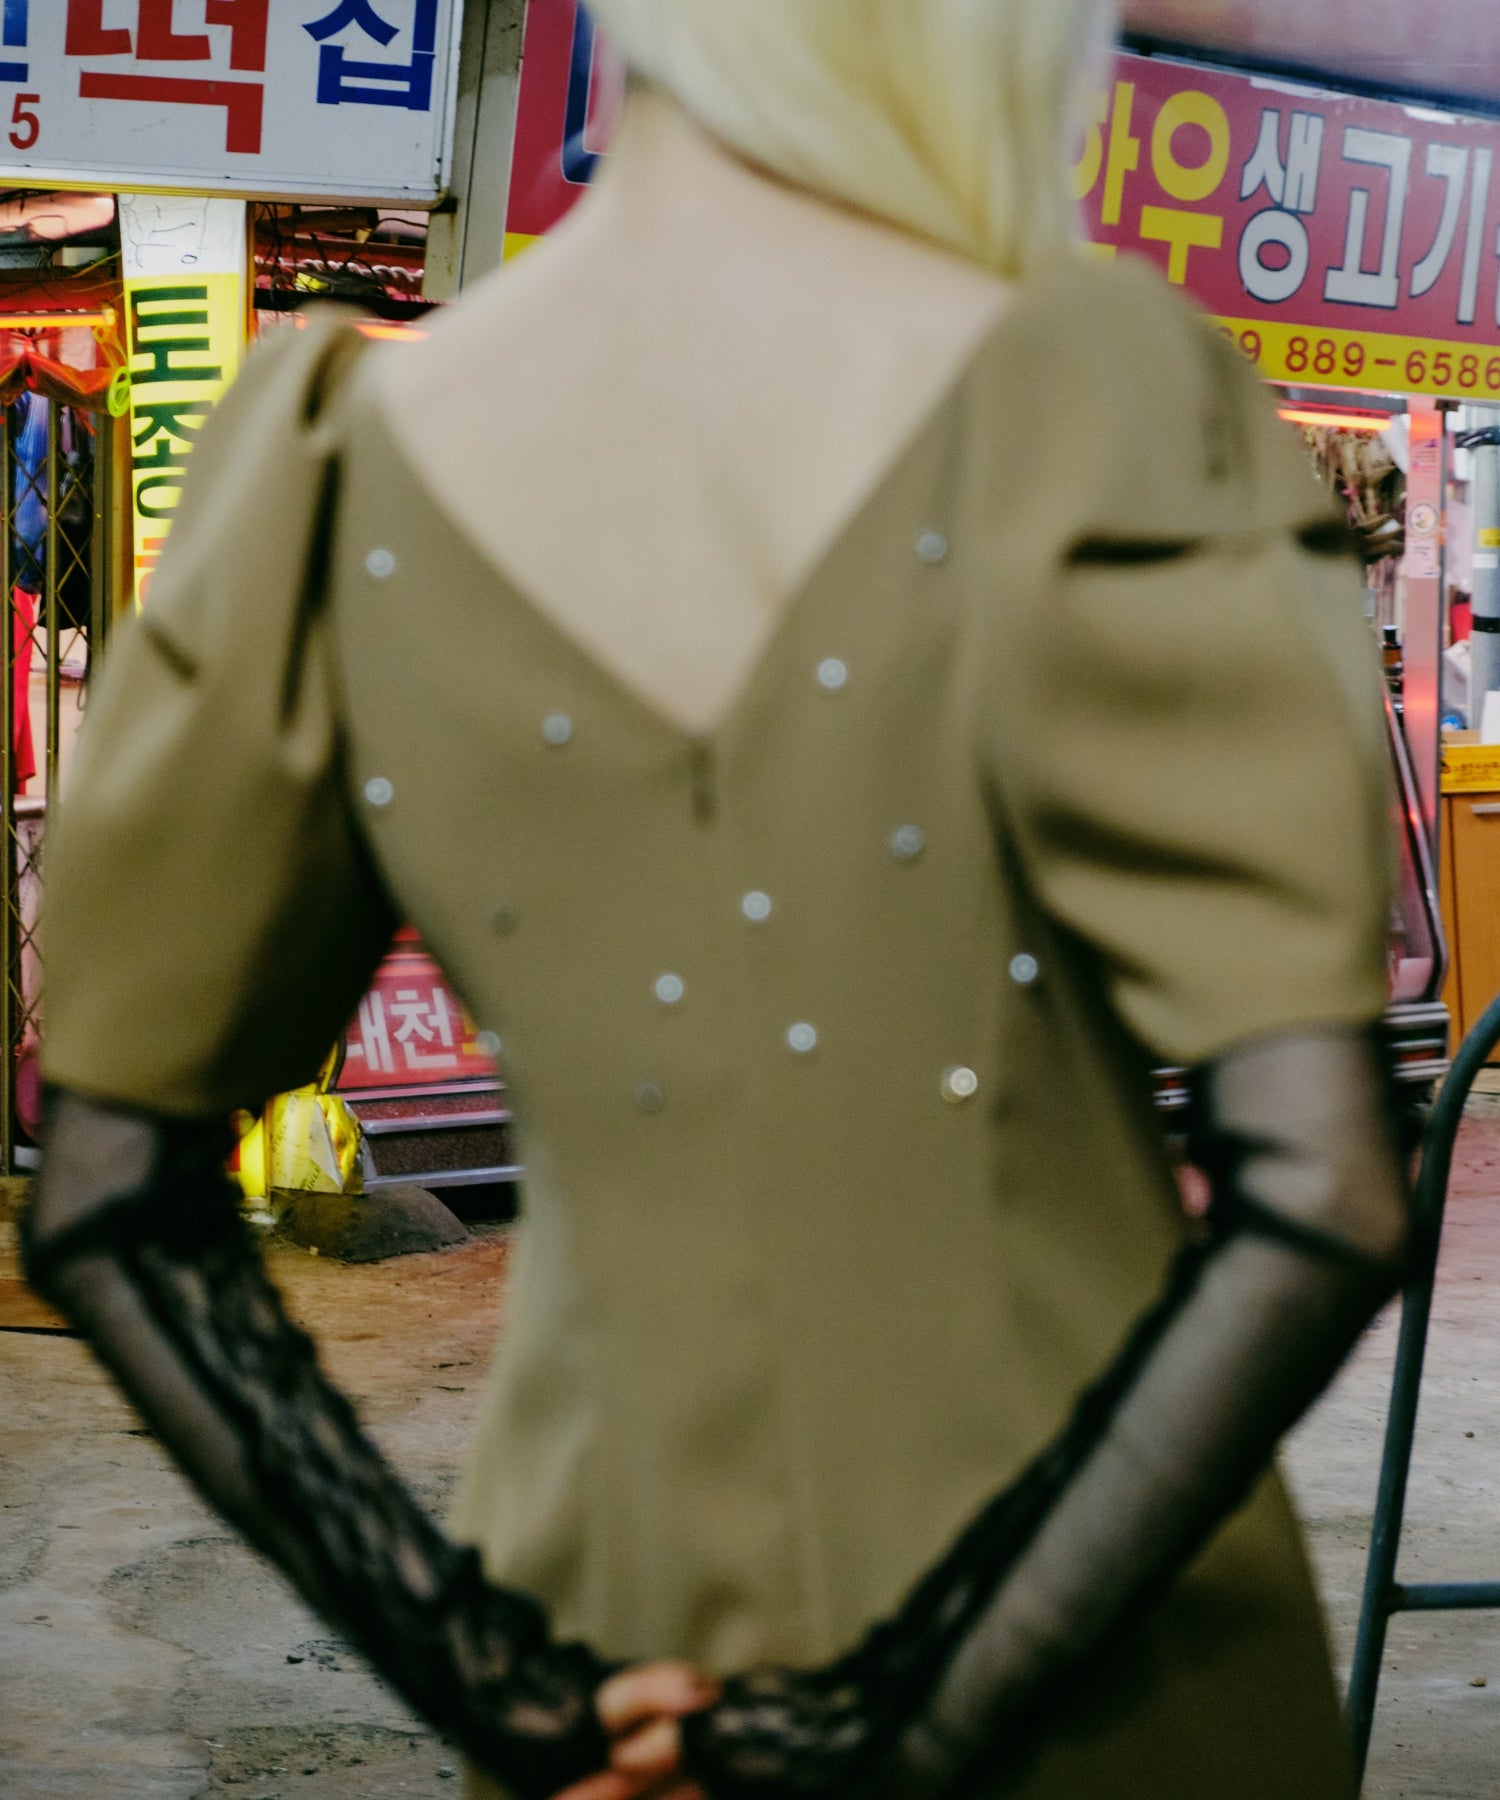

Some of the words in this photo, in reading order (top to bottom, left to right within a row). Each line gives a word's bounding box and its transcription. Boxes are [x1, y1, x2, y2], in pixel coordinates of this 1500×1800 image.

[0, 0, 436, 154] 떡집
[1239, 107, 1500, 327] 생고기
[1285, 335, 1500, 391] 889-6586
